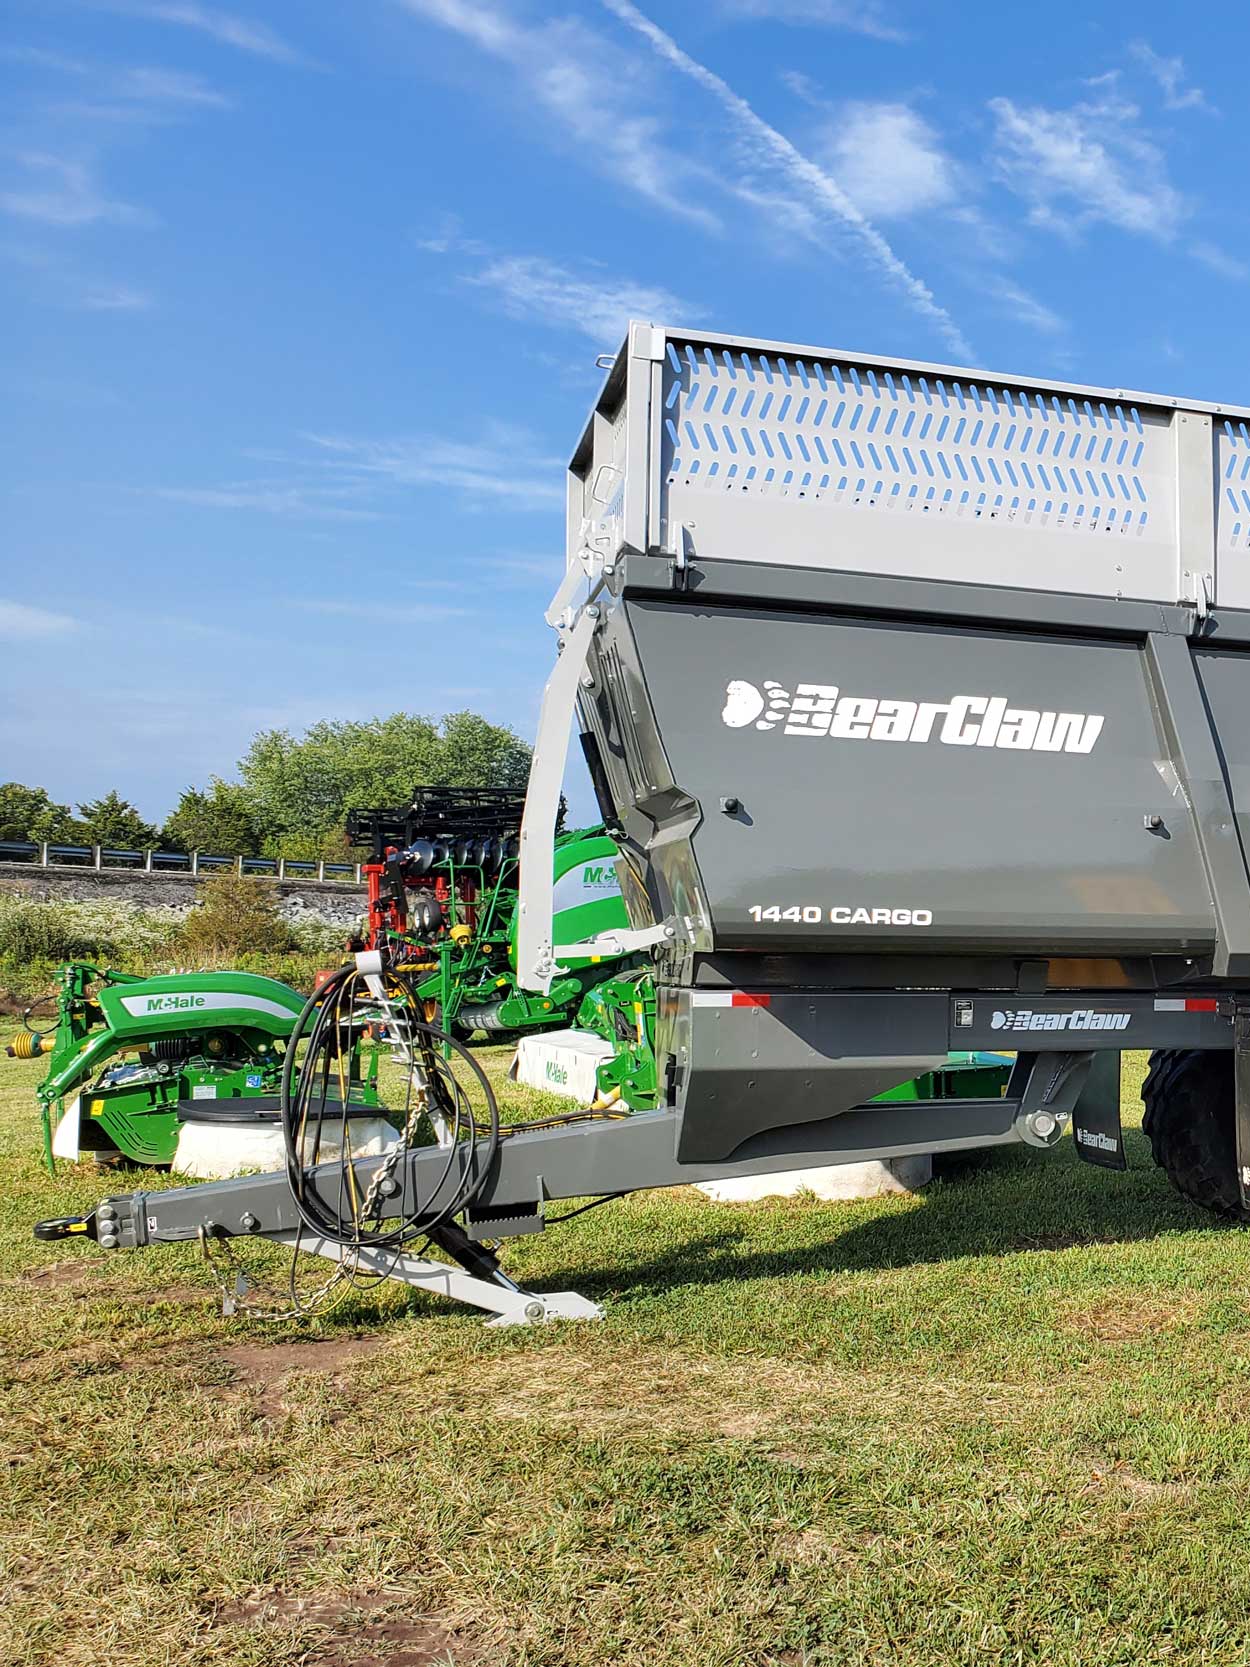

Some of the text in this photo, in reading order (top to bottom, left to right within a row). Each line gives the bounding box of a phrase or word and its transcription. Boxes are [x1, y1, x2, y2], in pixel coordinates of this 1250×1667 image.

[784, 683, 1104, 753] BearClaw
[748, 905, 933, 926] 1440 CARGO
[1012, 1009, 1132, 1031] BearClaw
[1083, 1129, 1118, 1153] BearClaw
